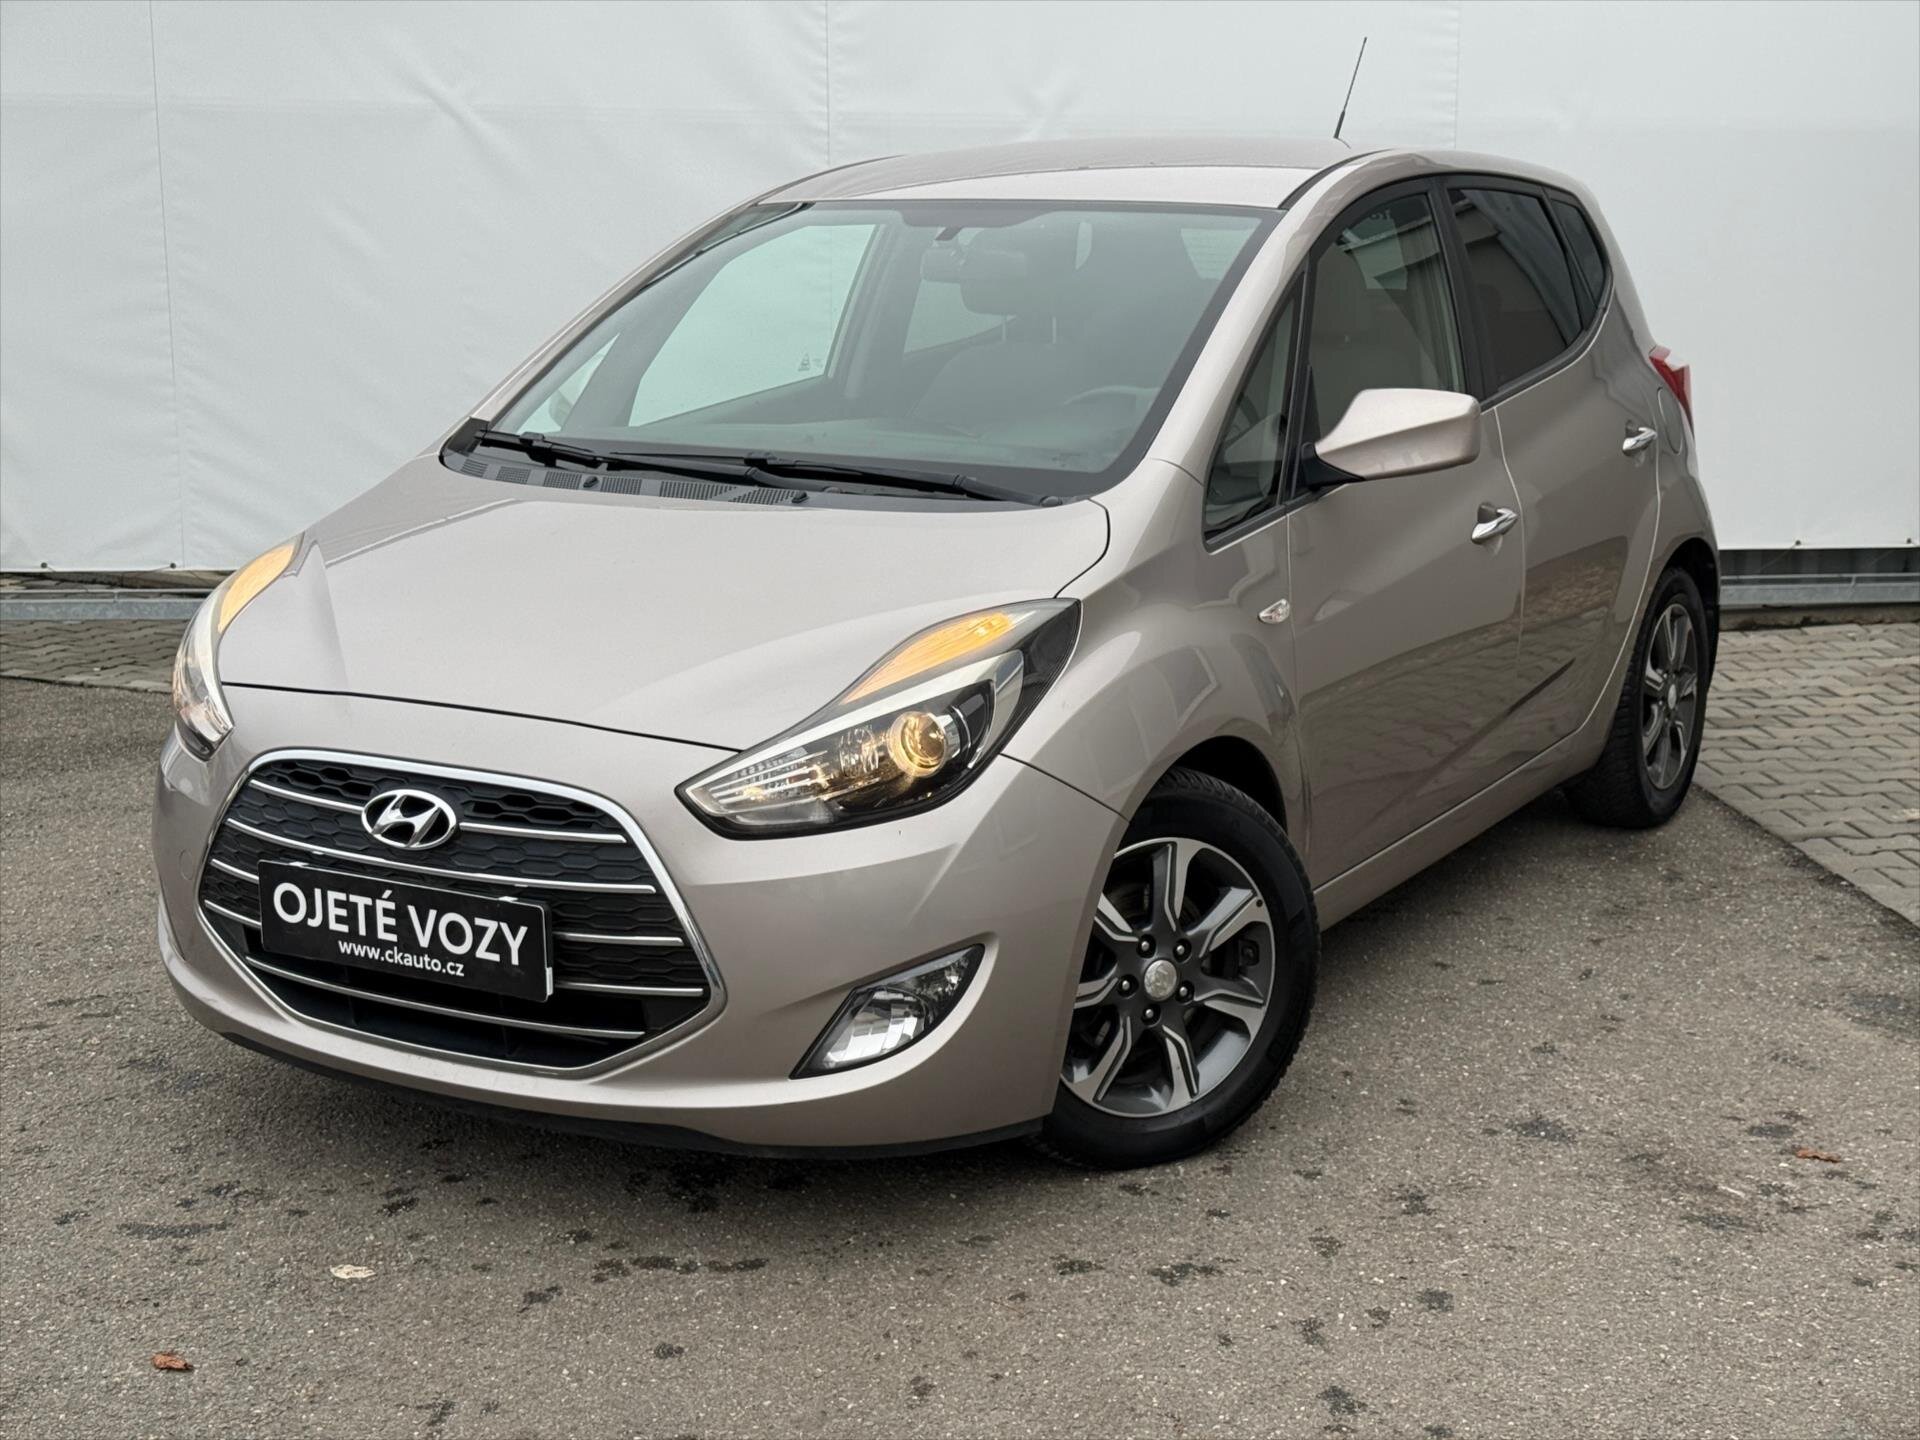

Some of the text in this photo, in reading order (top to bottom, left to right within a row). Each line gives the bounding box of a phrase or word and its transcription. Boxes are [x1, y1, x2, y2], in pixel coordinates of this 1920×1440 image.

[273, 882, 528, 966] OJETÉ VOZY
[338, 940, 465, 977] www.ckauto.cz
